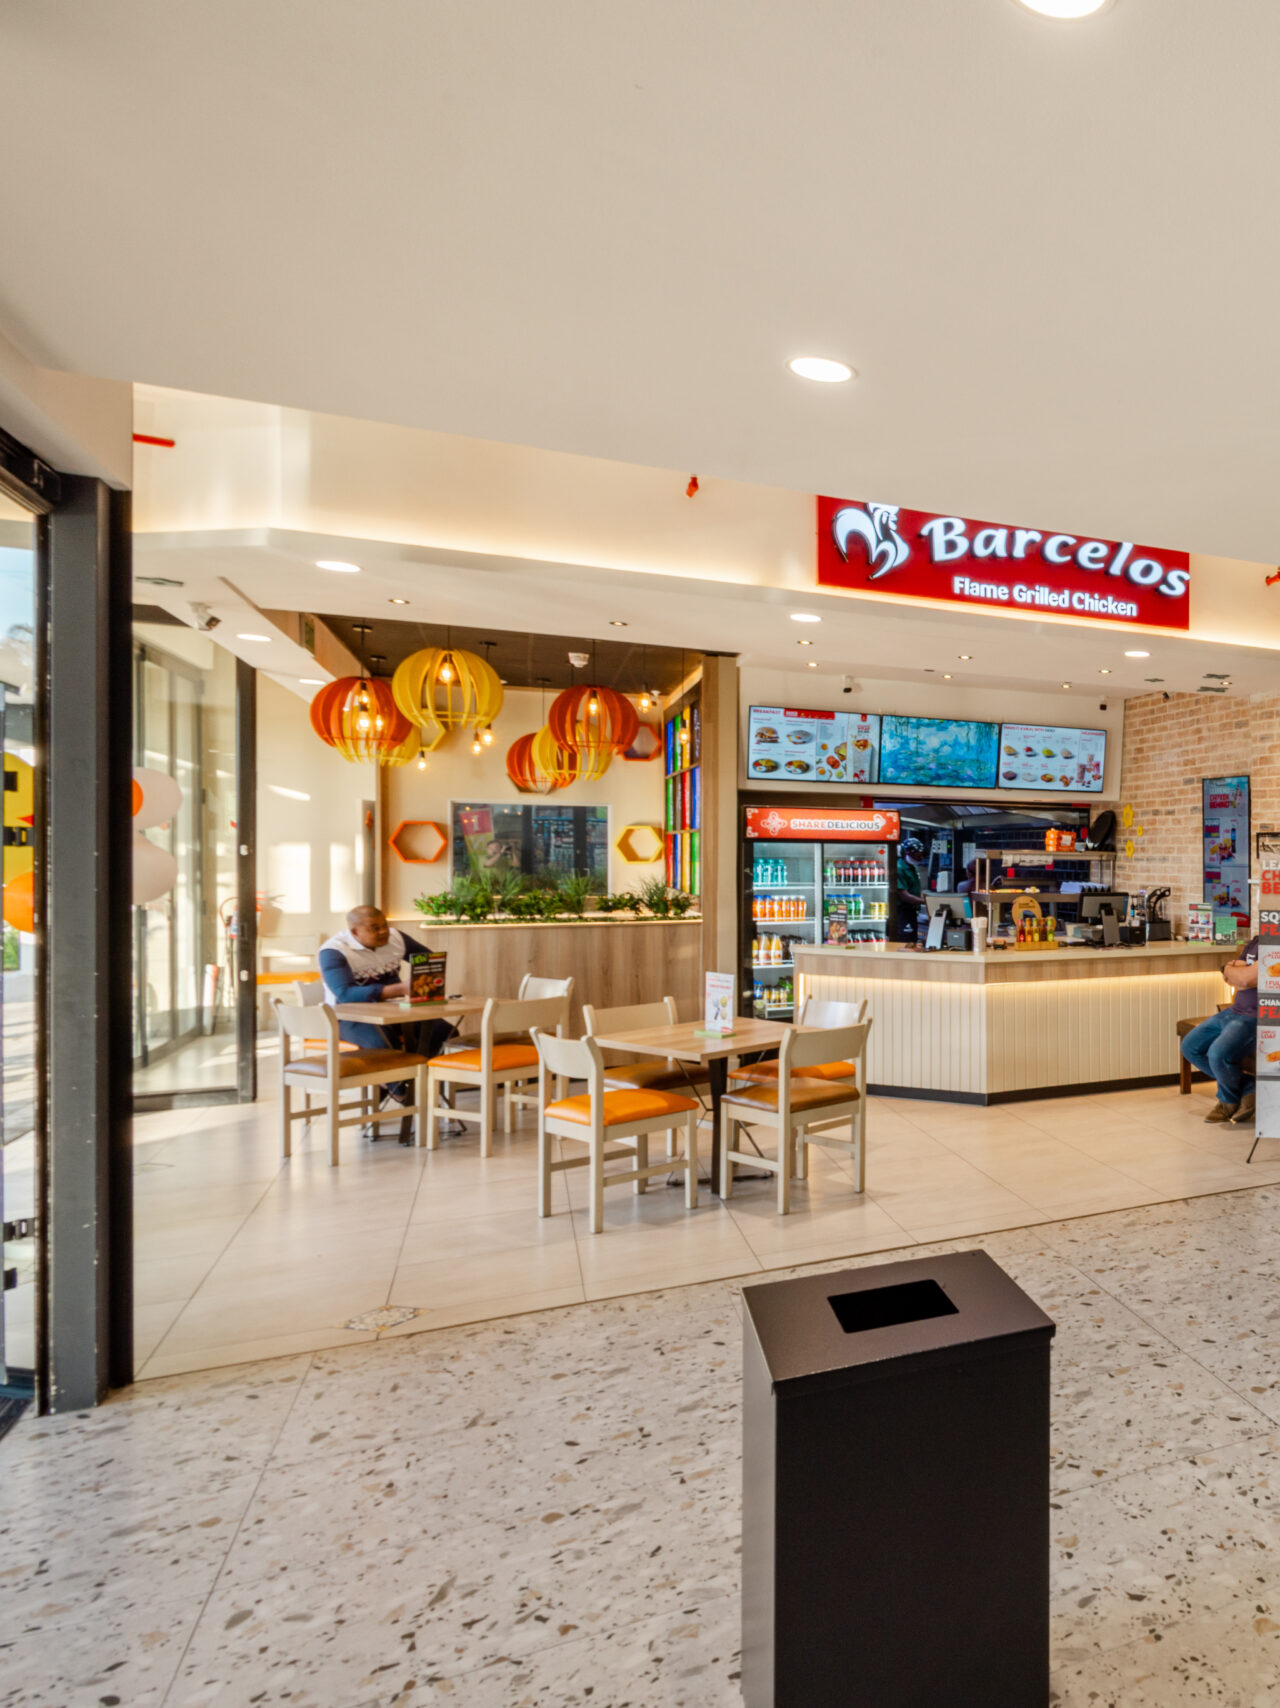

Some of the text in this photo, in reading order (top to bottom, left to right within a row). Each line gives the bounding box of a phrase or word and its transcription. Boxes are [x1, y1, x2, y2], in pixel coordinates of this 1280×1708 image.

[919, 516, 1191, 598] Barcelos
[952, 576, 1138, 617] Flame Grilled Chicken
